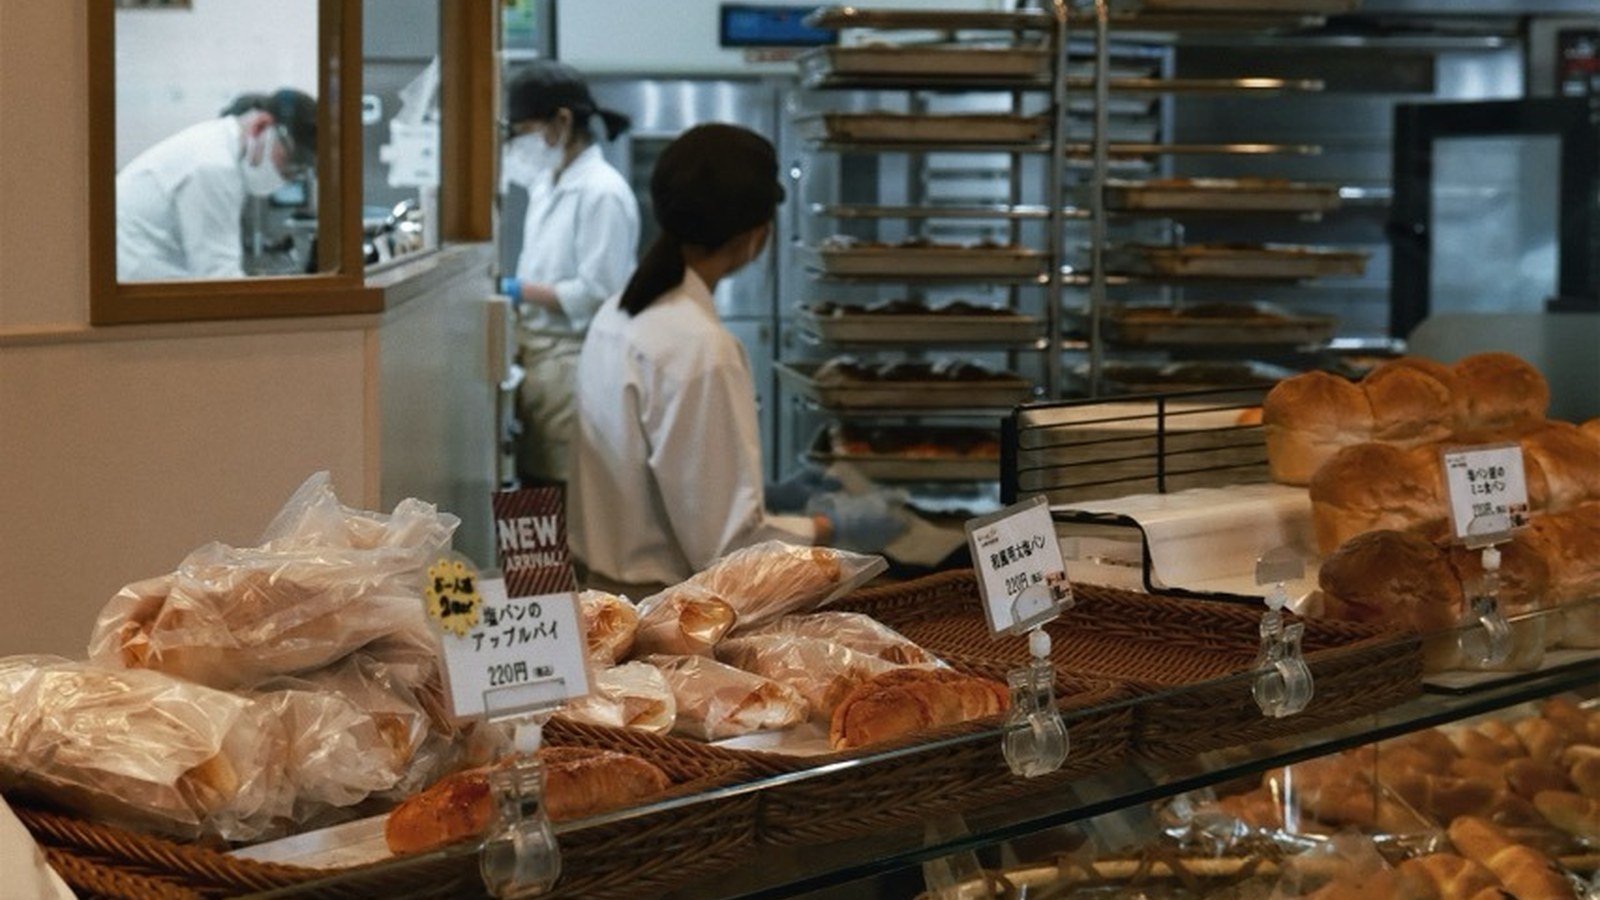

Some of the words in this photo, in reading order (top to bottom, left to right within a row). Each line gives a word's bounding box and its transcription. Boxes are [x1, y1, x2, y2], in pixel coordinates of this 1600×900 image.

[498, 515, 557, 551] NEW
[506, 550, 564, 572] ARRIVAL!
[483, 603, 542, 627] 塩パンの
[471, 621, 559, 652] アップルパイ
[487, 661, 529, 686] 220円
